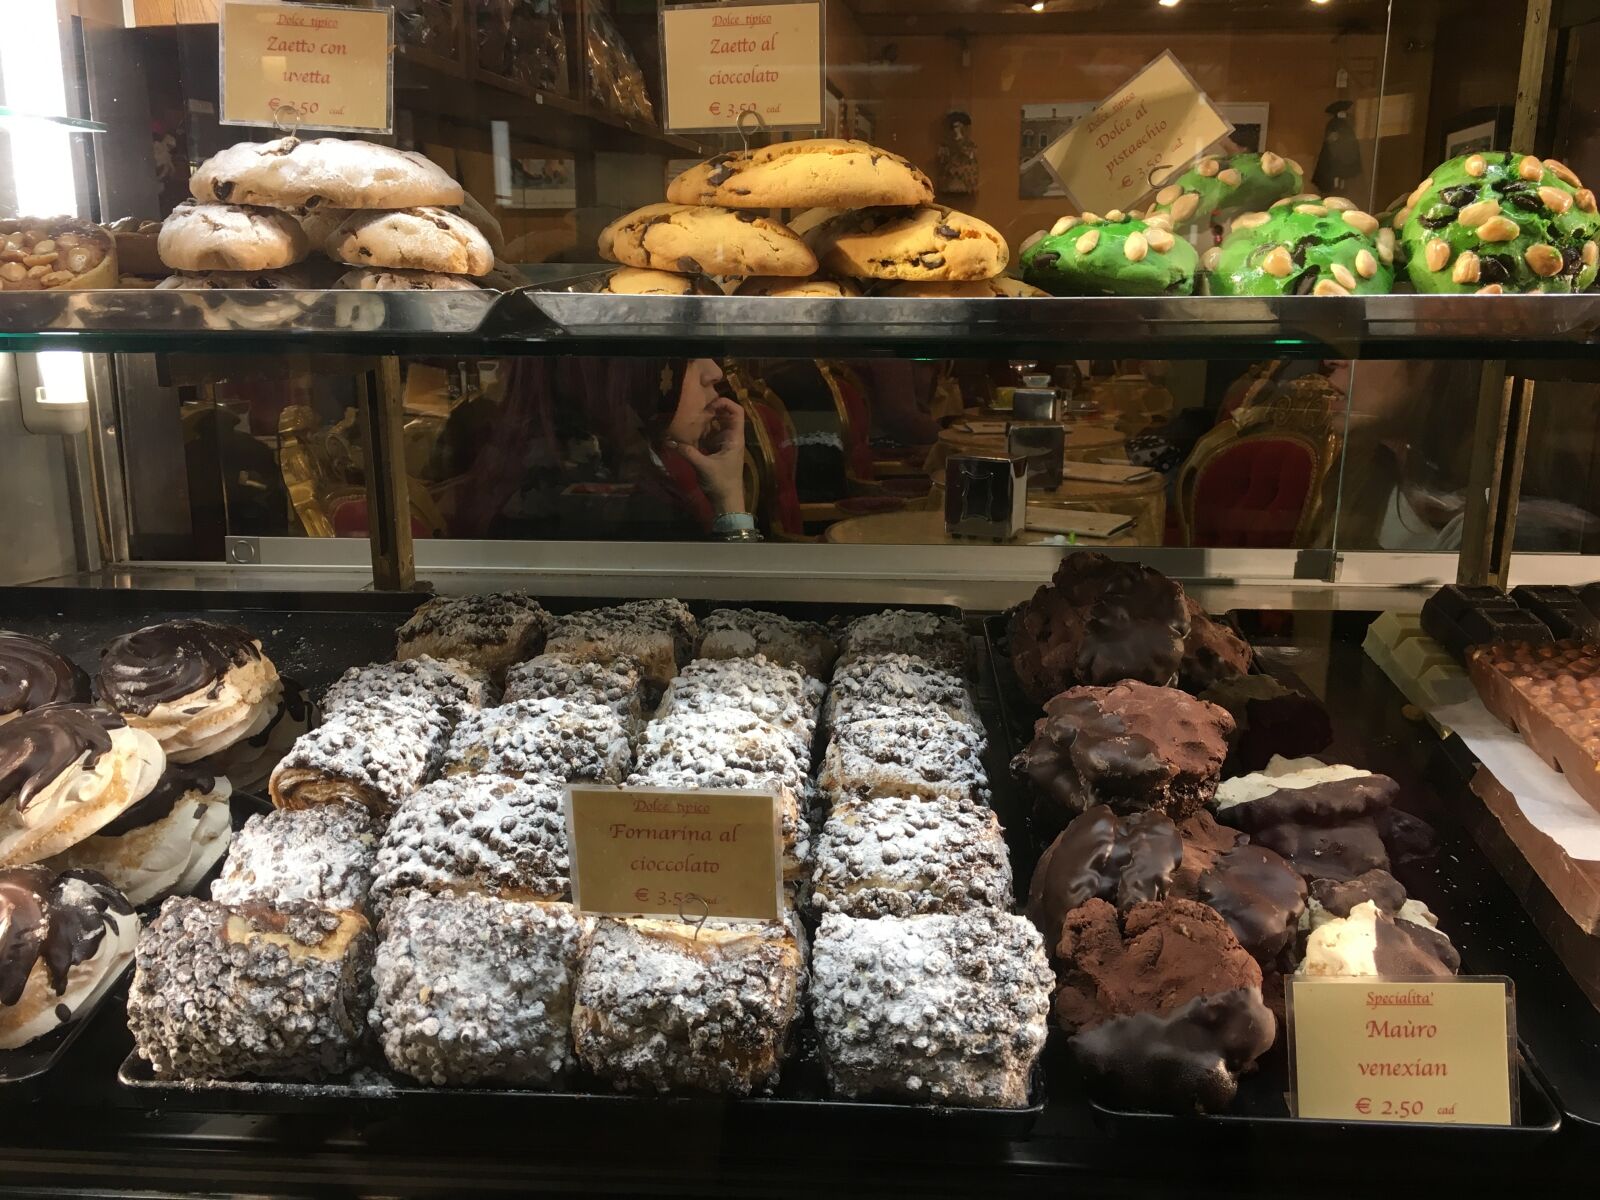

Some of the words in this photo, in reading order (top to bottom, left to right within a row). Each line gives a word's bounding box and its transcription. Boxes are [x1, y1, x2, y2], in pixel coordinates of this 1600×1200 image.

[276, 12, 305, 27] Dolce
[311, 17, 338, 30] tipico
[712, 12, 740, 27] Dolce
[745, 15, 772, 28] tipico
[267, 36, 316, 53] Zaetto
[320, 42, 348, 55] con
[710, 38, 756, 54] Zaetto
[761, 32, 779, 51] al
[283, 69, 331, 84] uvetta
[709, 64, 779, 85] cioccolato
[268, 98, 280, 111] €
[709, 102, 721, 116] €
[1095, 116, 1133, 149] Dolce
[1135, 99, 1149, 121] al
[633, 798, 670, 813] Dolce
[676, 802, 711, 818] tipico
[609, 823, 713, 842] Fornarina
[719, 823, 742, 842] al
[630, 853, 720, 874] cioccolato
[634, 887, 649, 902] €
[1366, 989, 1434, 1009] Specialita'
[1366, 1019, 1437, 1038] Maùro
[1355, 1097, 1372, 1115] €
[1381, 1100, 1424, 1118] 2.50
